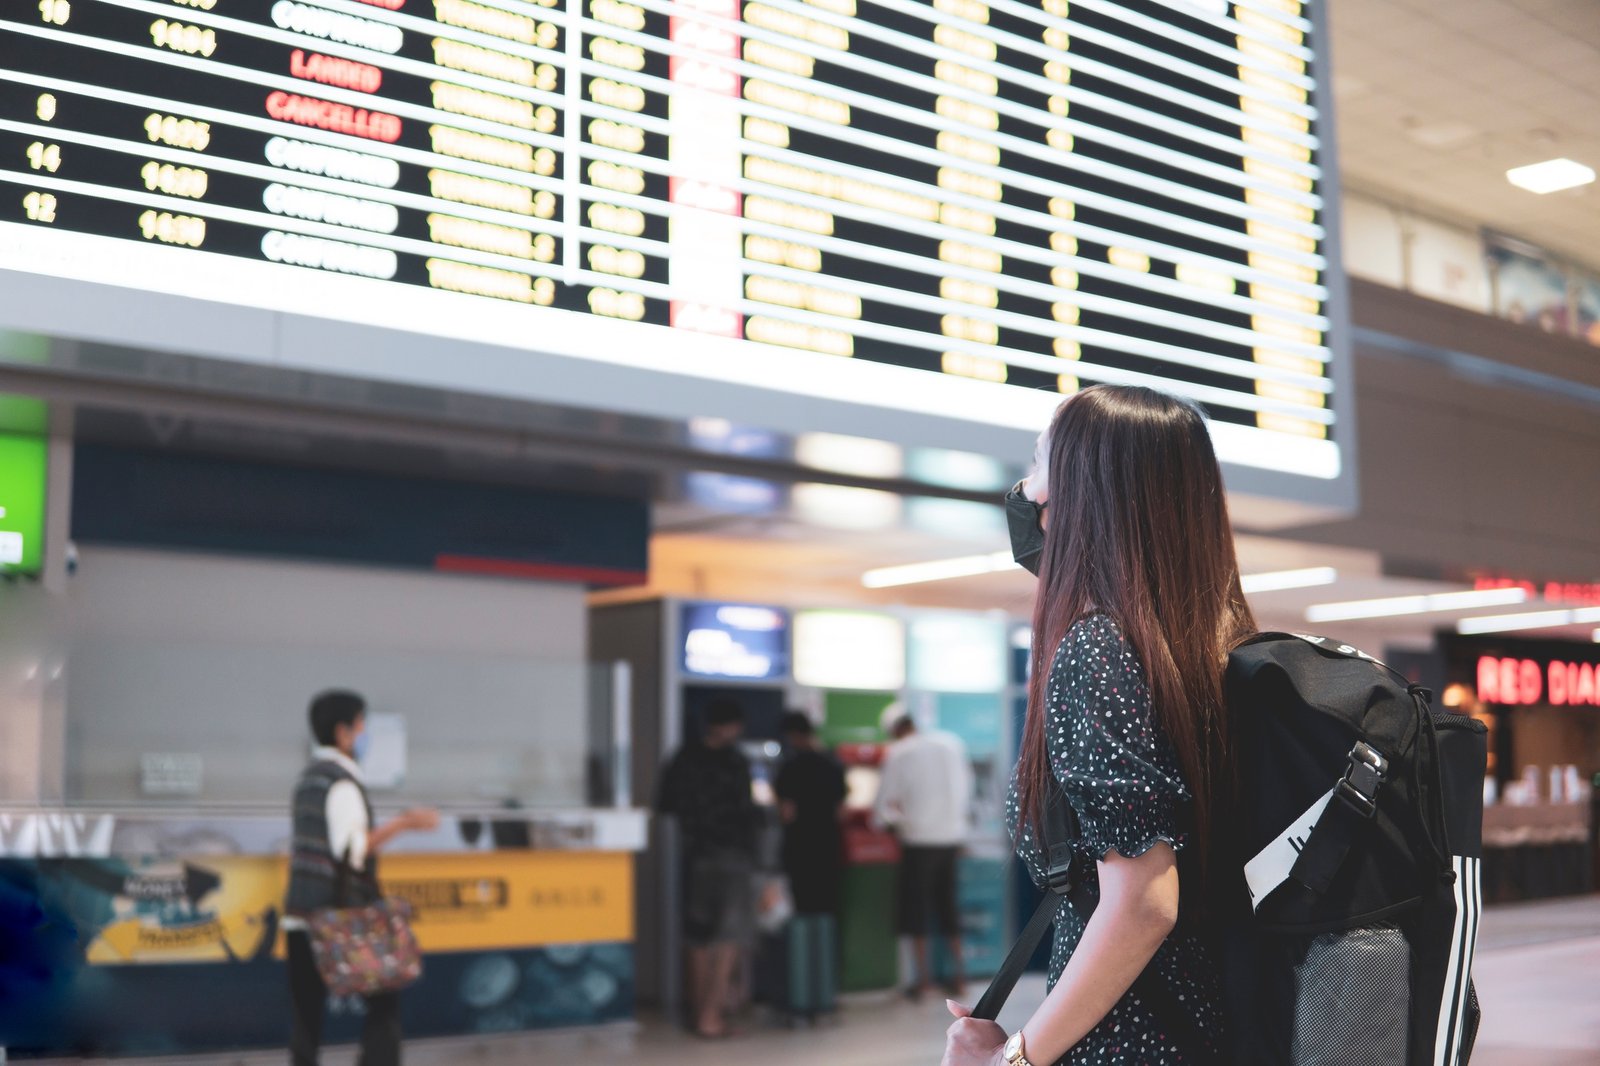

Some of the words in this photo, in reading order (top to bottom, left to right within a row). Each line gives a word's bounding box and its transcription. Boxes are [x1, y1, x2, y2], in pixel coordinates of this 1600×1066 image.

[290, 50, 381, 93] LANDED
[266, 91, 401, 142] CANCELLED
[1477, 655, 1542, 705] RED
[1548, 660, 1600, 706] DIA
